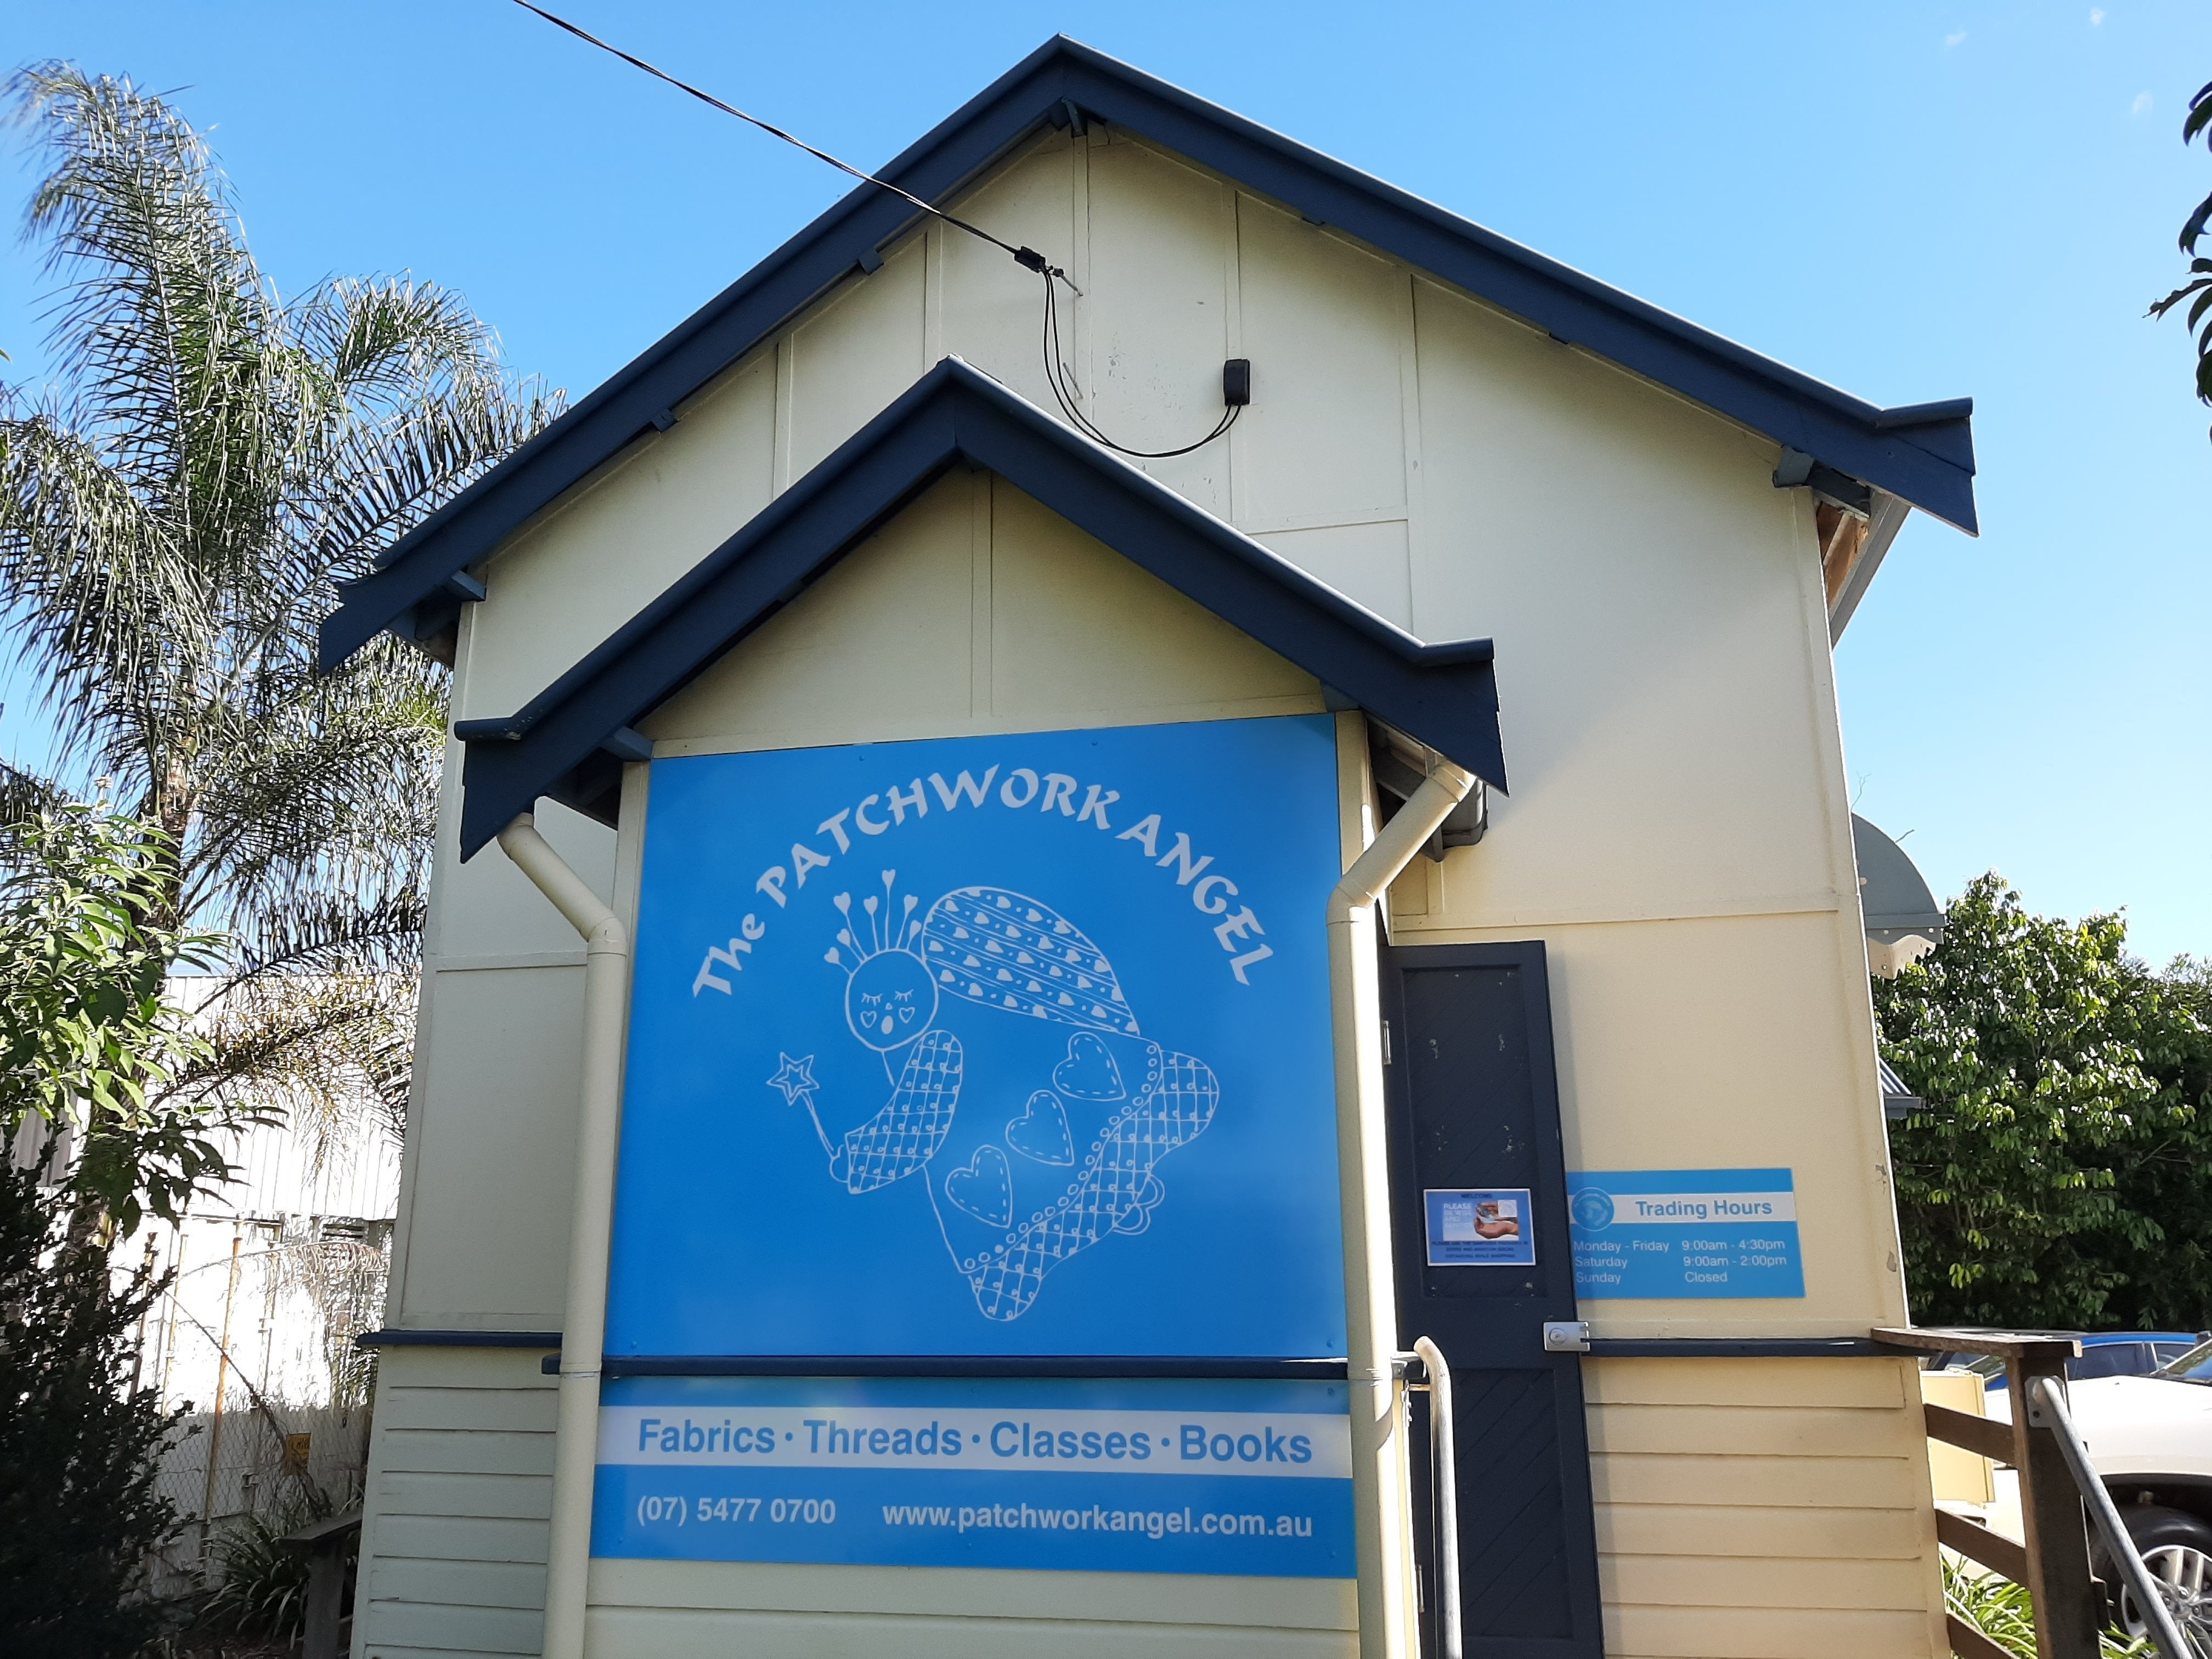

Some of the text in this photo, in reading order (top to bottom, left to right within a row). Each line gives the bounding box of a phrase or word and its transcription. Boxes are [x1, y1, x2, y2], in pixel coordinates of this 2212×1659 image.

[692, 763, 1274, 997] The PATCHWORK ANGEL
[1635, 1199, 1773, 1220] Trading Hours
[1573, 1240, 1621, 1254] Monday
[1632, 1240, 1670, 1253] Friday
[1681, 1240, 1727, 1251] 9:00am
[1739, 1239, 1785, 1252] 4:30pm
[1575, 1256, 1628, 1269] Saturday
[1683, 1256, 1728, 1266] 9:00am
[1740, 1255, 1787, 1267] 2:00pm
[1576, 1271, 1728, 1285] Sunday Closed
[639, 1419, 1313, 1464] Fabrics Threads Classes Books
[637, 1497, 1313, 1539] (07) 5477 0700 www.patchworkangel.com.au
